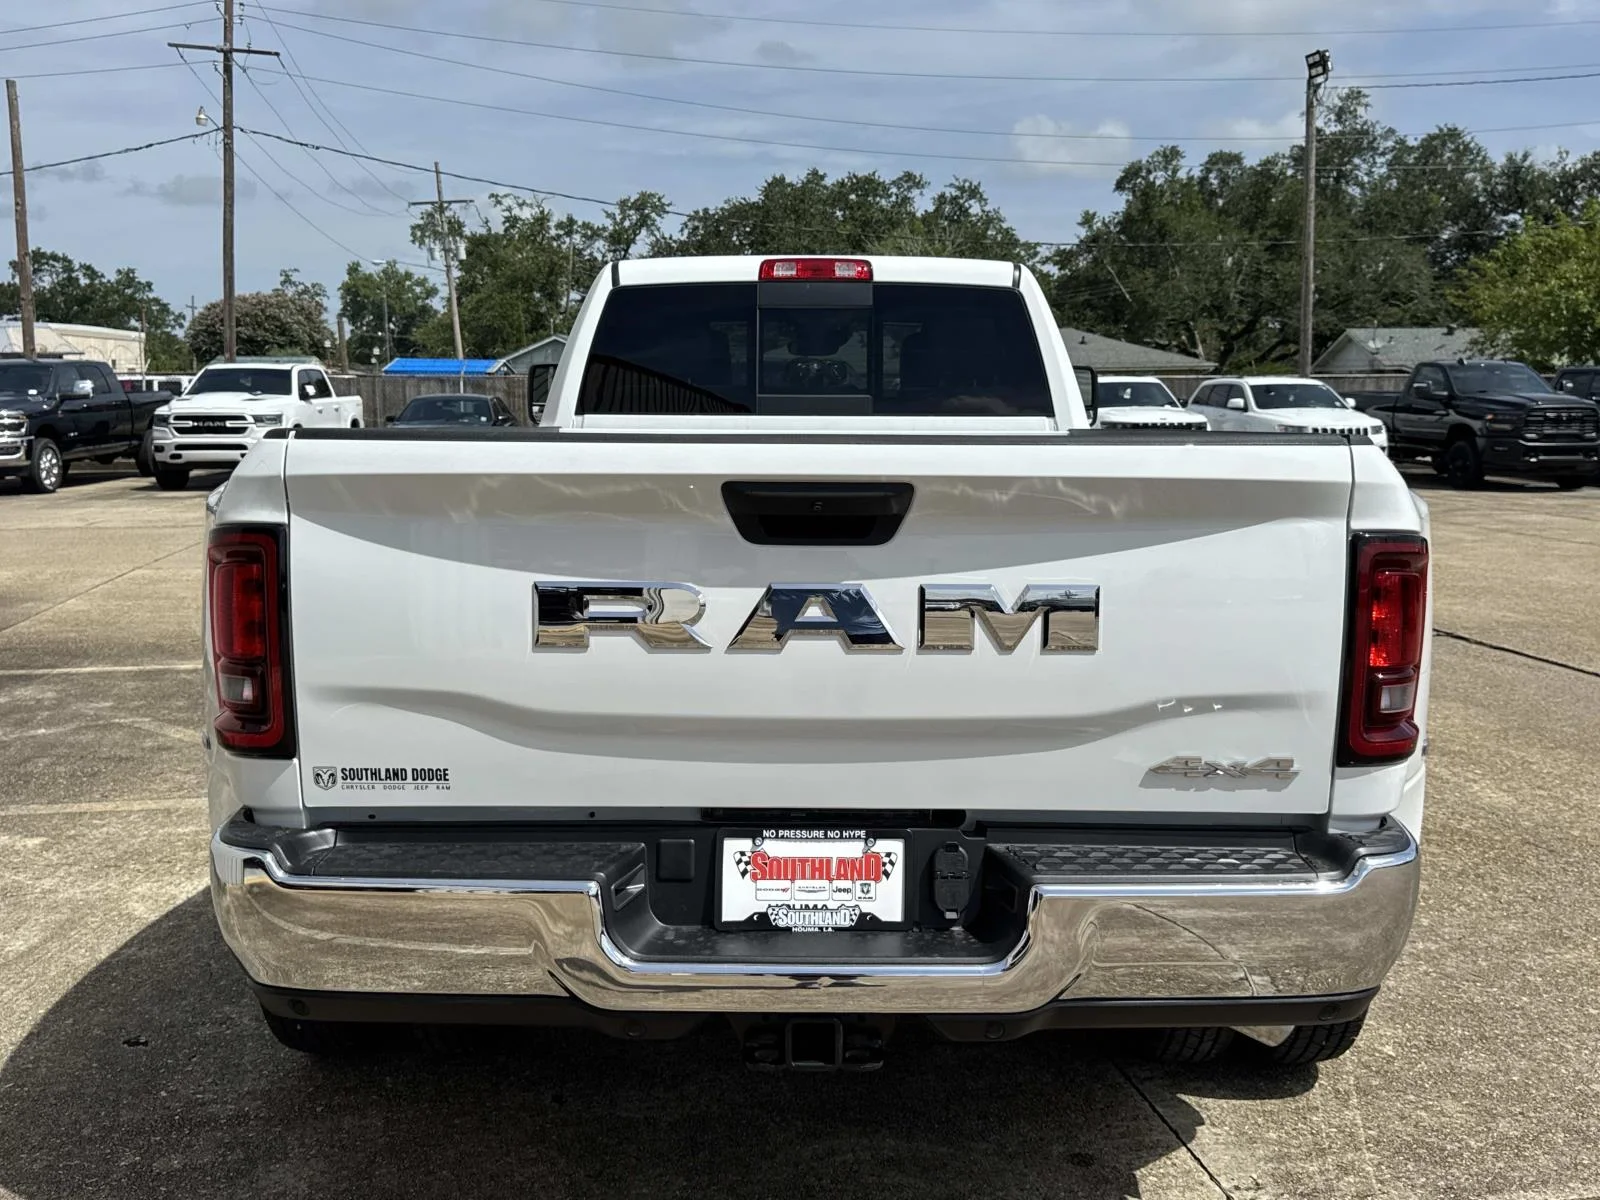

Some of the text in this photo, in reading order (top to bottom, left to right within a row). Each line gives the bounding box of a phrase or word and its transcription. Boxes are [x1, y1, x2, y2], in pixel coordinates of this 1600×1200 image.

[533, 581, 1102, 652] RAM
[340, 767, 450, 782] SOUTHLAND DODGE
[762, 829, 866, 839] NO PRESSURE NO HYPE
[751, 851, 882, 882] SOUTHLAND
[778, 908, 850, 926] SOUTHLAND
